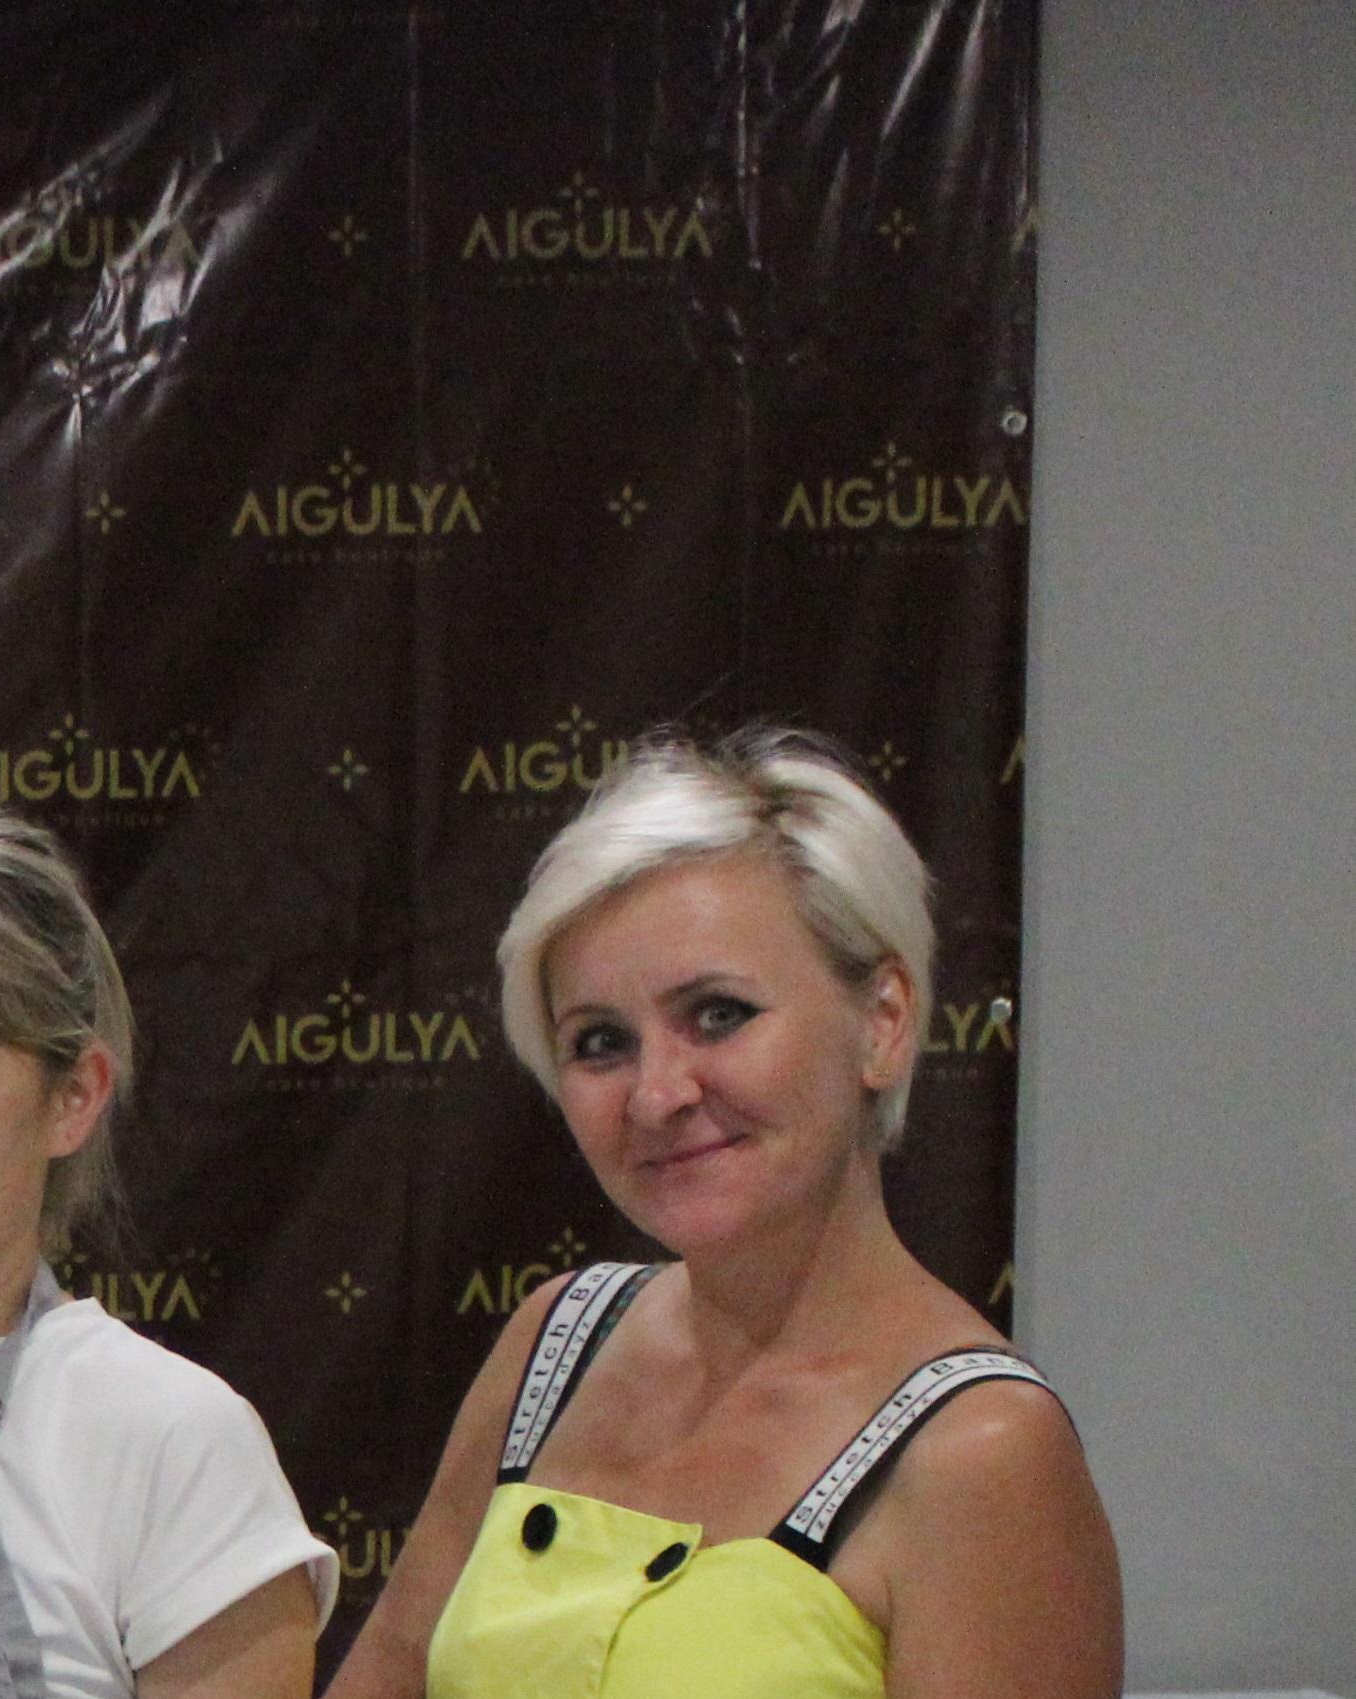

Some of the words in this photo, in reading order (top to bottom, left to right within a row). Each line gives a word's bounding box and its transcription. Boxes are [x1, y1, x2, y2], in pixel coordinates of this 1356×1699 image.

[462, 205, 714, 260] AIGULYA
[231, 483, 483, 537] AIGULYA
[781, 475, 1027, 529] AIGULYA
[231, 1012, 481, 1065] AIGULYA
[794, 1392, 912, 1524] Stretch
